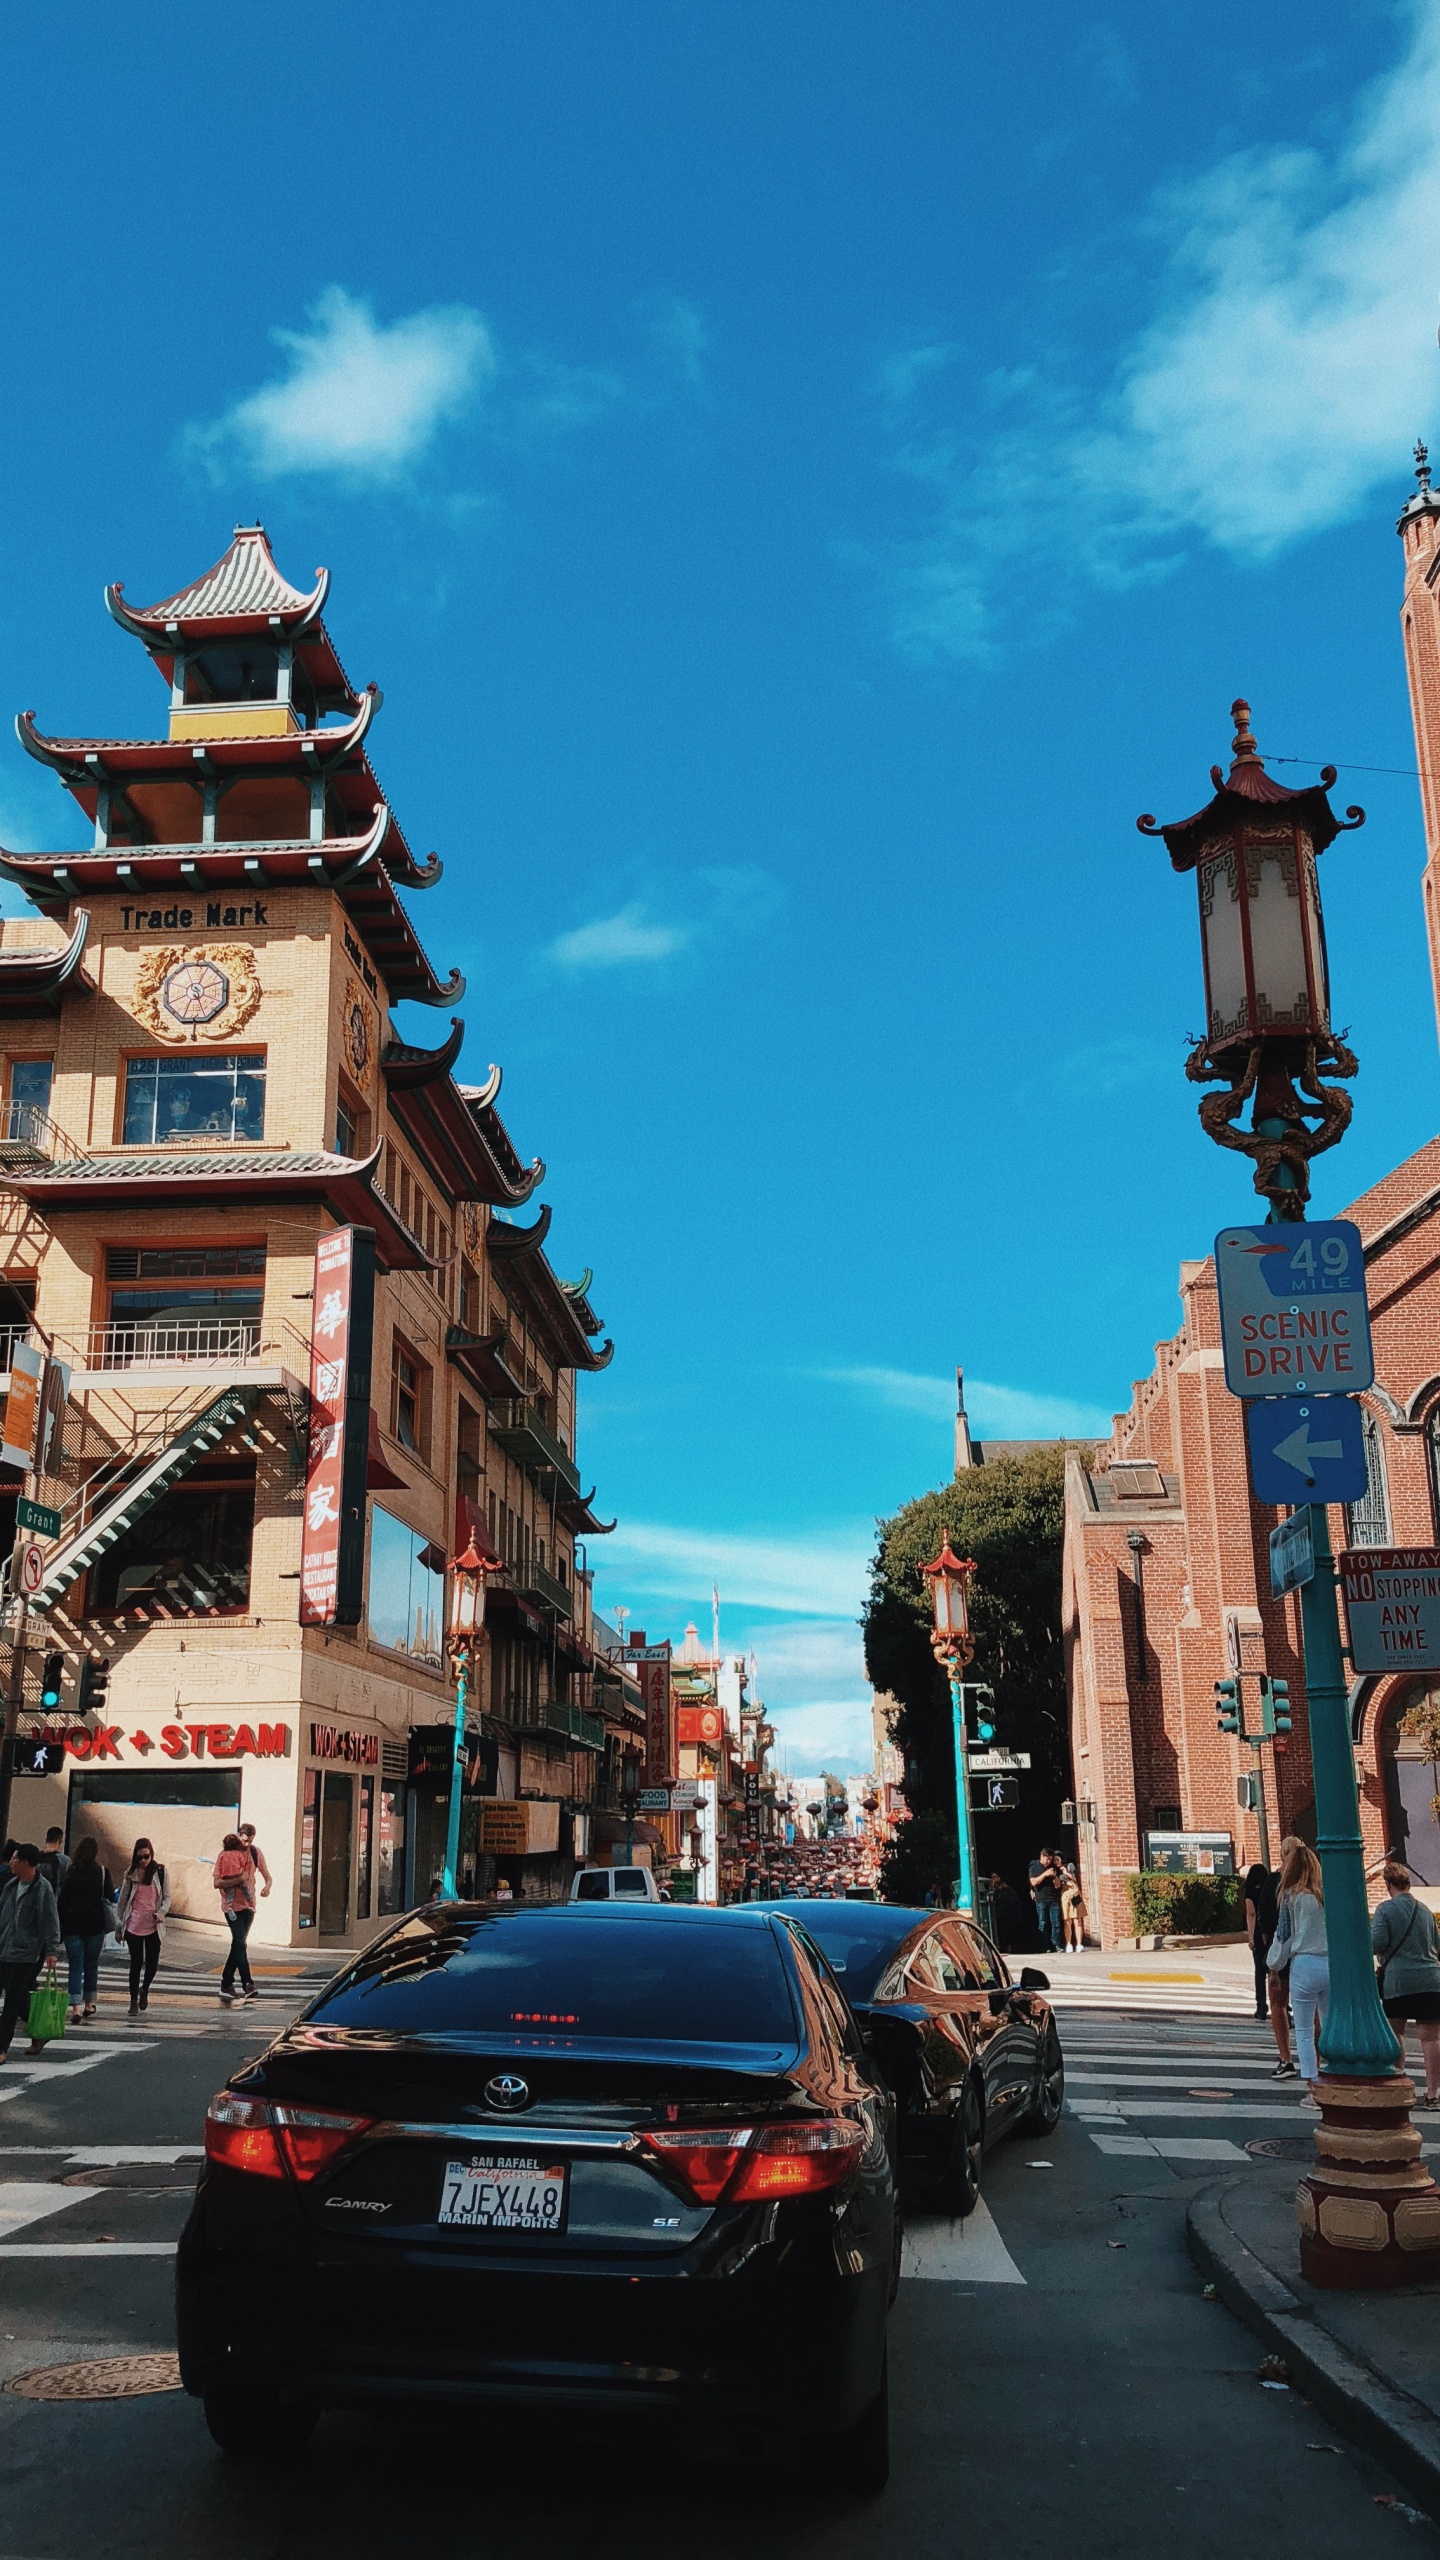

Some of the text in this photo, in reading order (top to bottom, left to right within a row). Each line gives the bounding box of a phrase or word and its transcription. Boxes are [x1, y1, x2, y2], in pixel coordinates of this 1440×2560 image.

[120, 901, 268, 930] Trade Mark
[131, 1061, 154, 1073] 625
[160, 1058, 191, 1072] GRANT
[318, 1238, 342, 1257] WELCOME
[1290, 1237, 1349, 1277] 49
[1291, 1276, 1351, 1291] MILE
[1240, 1310, 1349, 1342] SCENIC
[1244, 1343, 1353, 1377] DRIVE
[27, 1508, 54, 1531] Grant
[304, 1566, 337, 1585] RESTAURANT
[1345, 1573, 1440, 1600] NO STOPPIN
[1381, 1605, 1420, 1625] ANY
[27, 1620, 50, 1635] GRANT
[1379, 1629, 1428, 1651] TIME
[626, 1649, 666, 1658] Far East
[160, 1723, 286, 1755] STEAM
[312, 1724, 338, 1759] WOK
[345, 1731, 378, 1764] STEAM
[975, 1757, 1025, 1766] CALIFORNIA
[471, 2156, 540, 2170] SAN RAFAEL
[449, 2164, 465, 2173] DEC
[468, 2167, 543, 2184] California
[325, 2197, 393, 2212] CAMRY
[448, 2182, 558, 2218] 7JEX448
[438, 2212, 559, 2229] MARIN IMPORTS
[652, 2218, 680, 2227] SE
